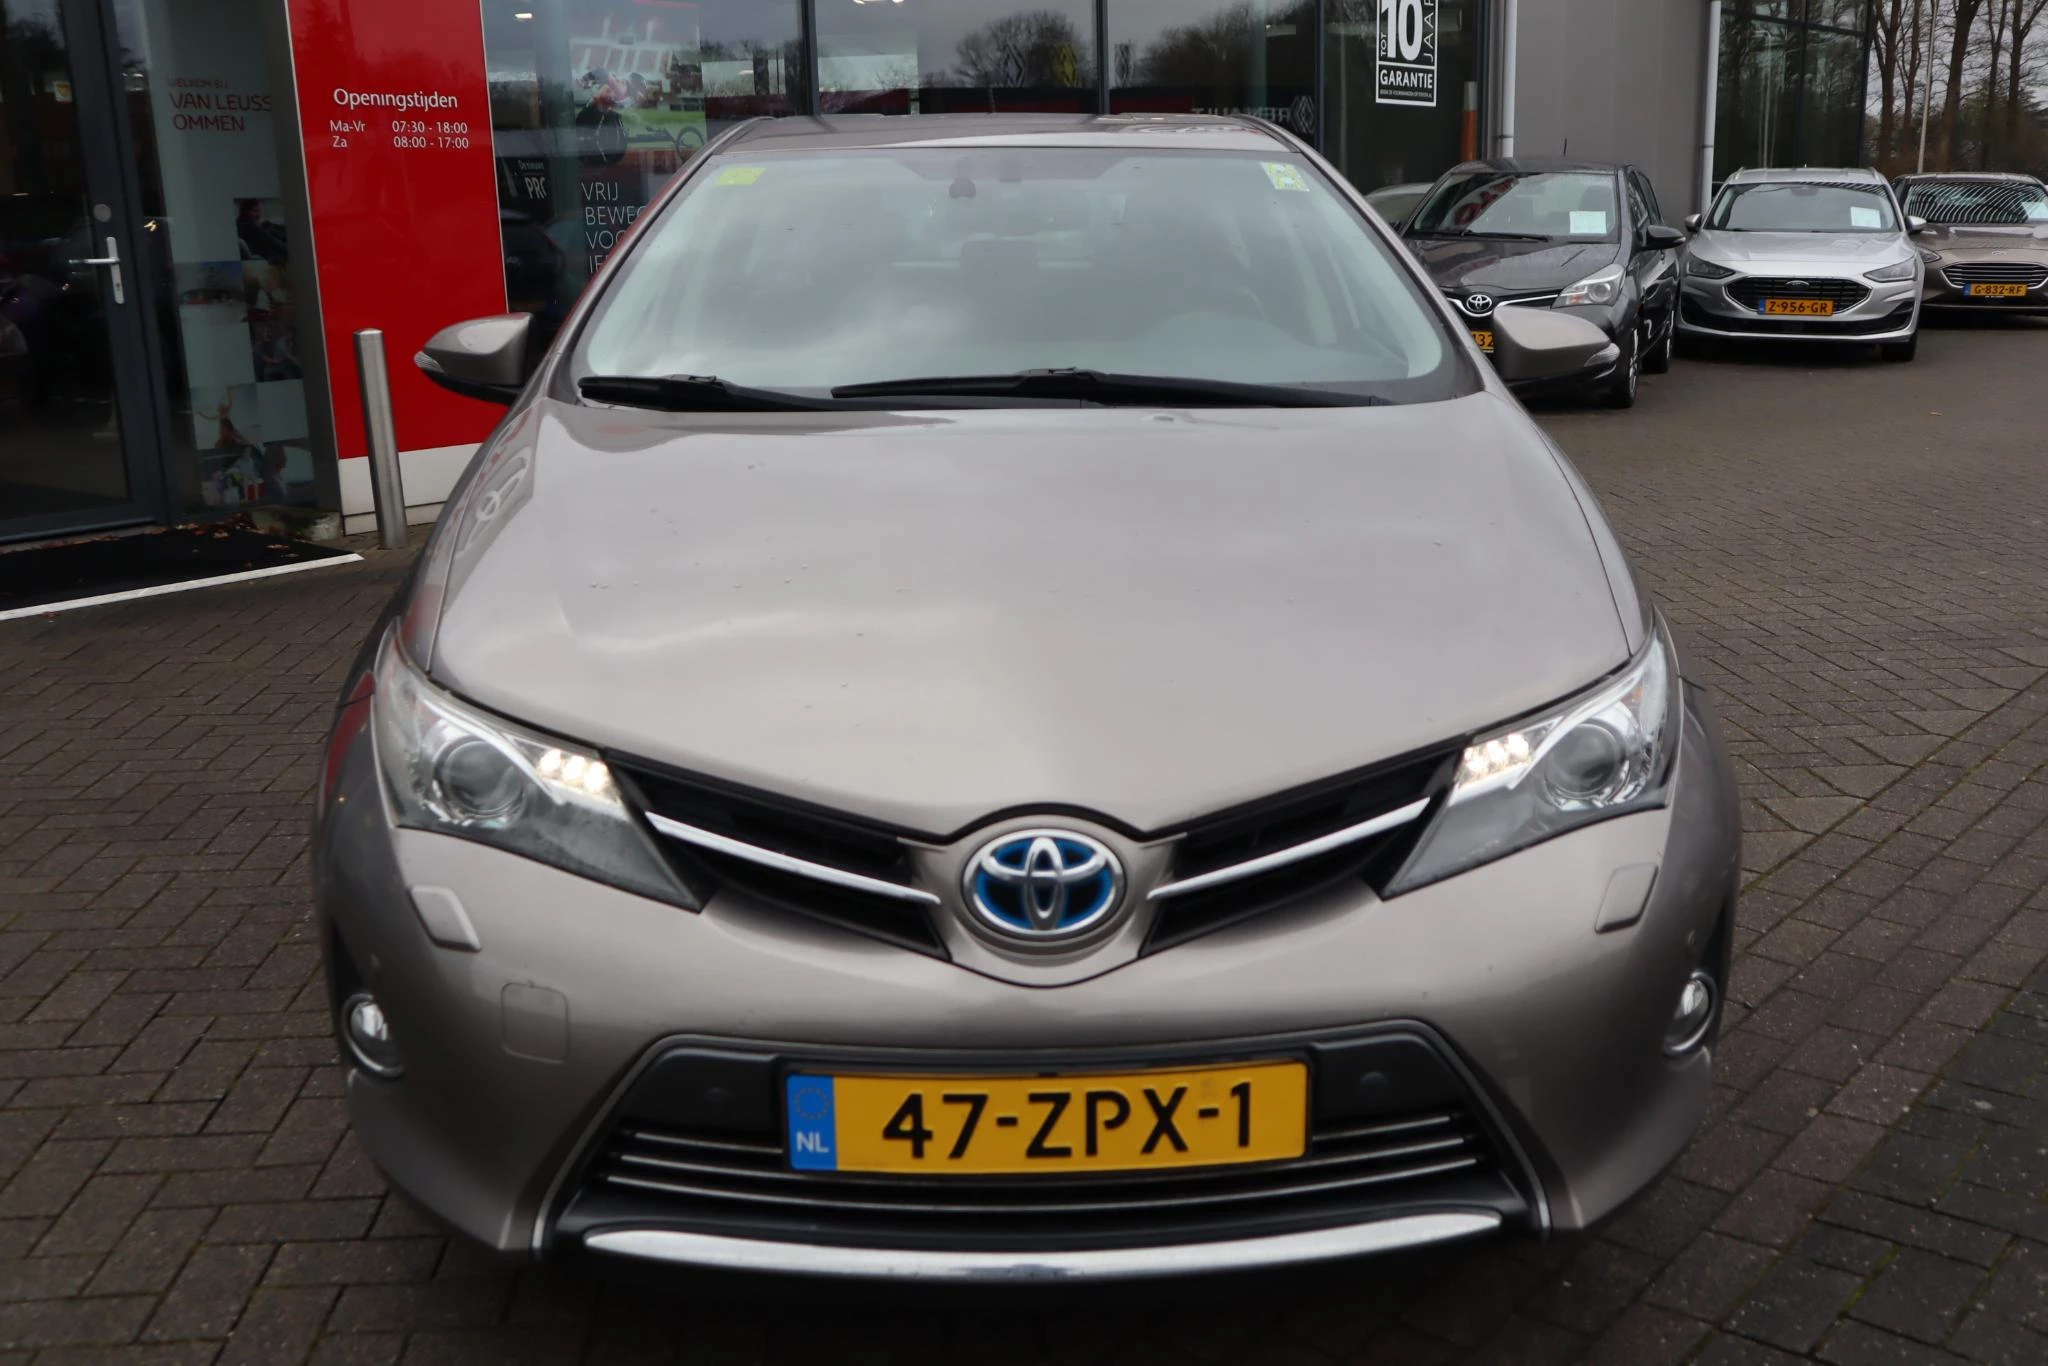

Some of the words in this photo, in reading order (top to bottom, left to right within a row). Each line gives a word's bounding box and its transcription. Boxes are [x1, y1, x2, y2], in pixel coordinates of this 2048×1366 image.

[1381, 0, 1423, 61] 10
[1380, 69, 1433, 89] GARANTIE
[169, 92, 211, 110] VAN
[333, 88, 458, 112] Openingstijden
[173, 114, 245, 131] OMMEN
[330, 120, 366, 133] Ma-Vr
[392, 121, 425, 133] 07:30
[436, 122, 468, 134] 18:00
[332, 135, 348, 148] Za
[393, 136, 427, 148] 08:00
[438, 137, 469, 149] 17:00
[581, 182, 619, 201] VRIJ
[1974, 285, 2023, 295] G-832-RF
[1768, 301, 1828, 313] Z-956-GR
[1472, 333, 1494, 347] 32
[882, 1081, 1252, 1159] 47-ZPX-1
[796, 1131, 829, 1154] NL
